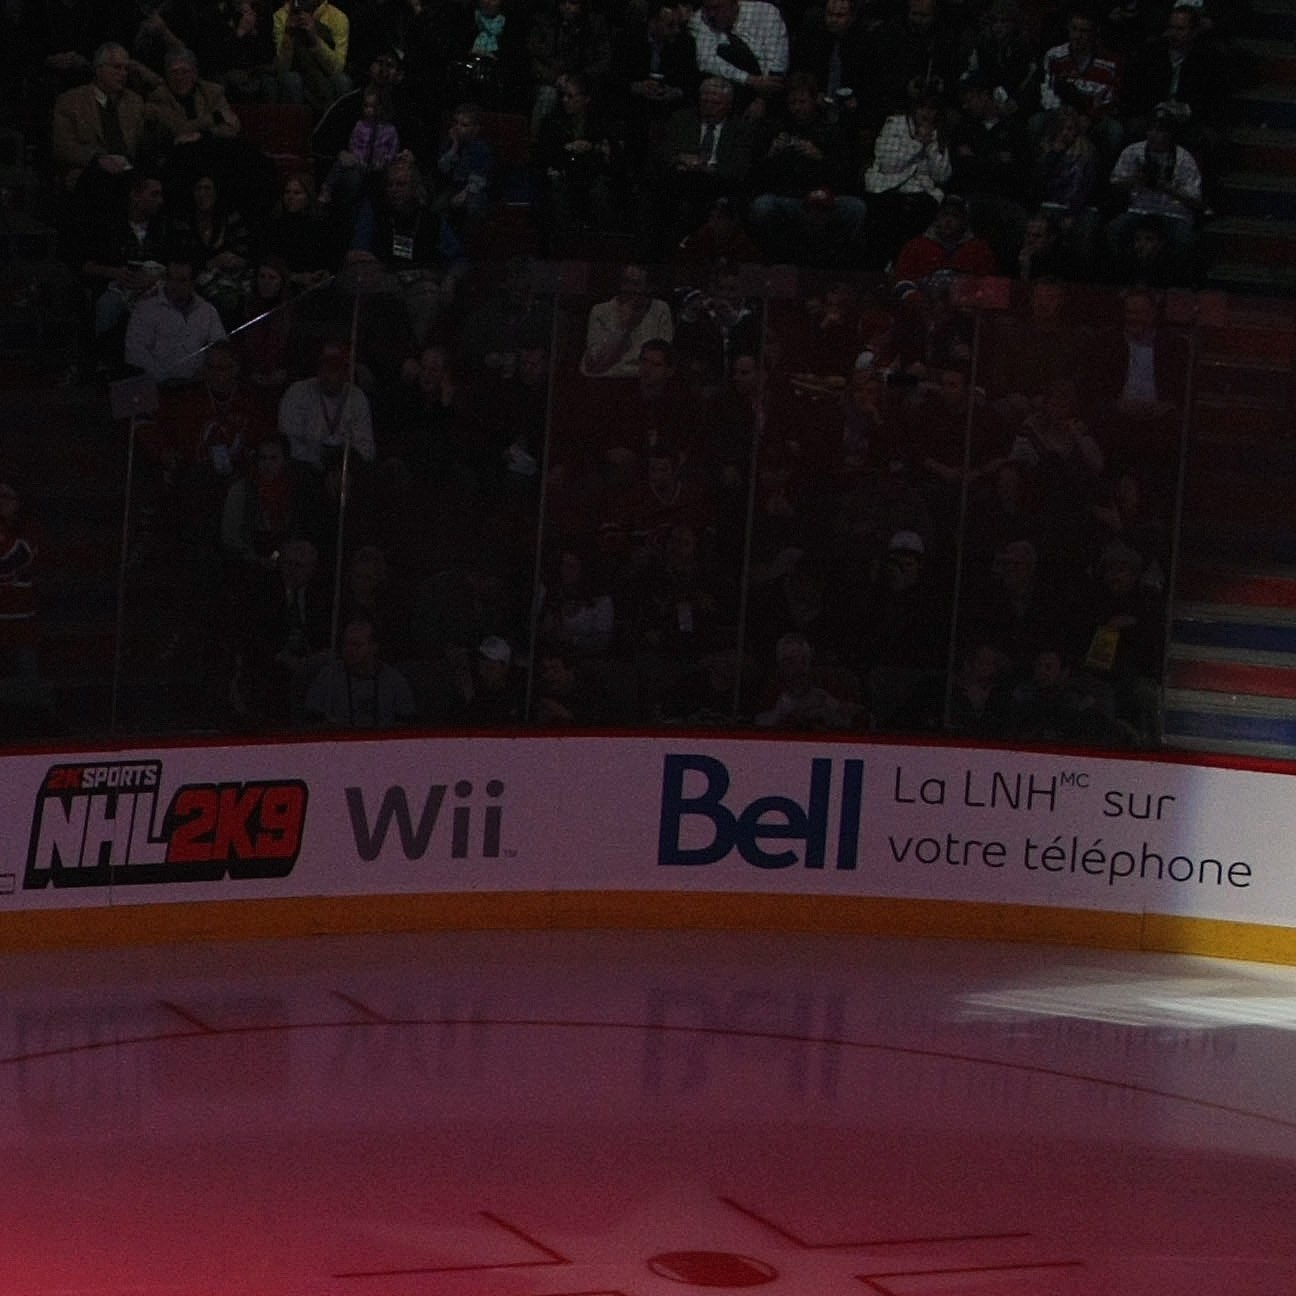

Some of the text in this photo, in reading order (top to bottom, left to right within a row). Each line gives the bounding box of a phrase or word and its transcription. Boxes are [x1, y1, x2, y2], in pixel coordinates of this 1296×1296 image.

[345, 779, 506, 861] Wii
[657, 754, 864, 870] Bell
[893, 767, 946, 804] La
[1103, 790, 1176, 820] sur
[889, 834, 1252, 888] votre téléphone
